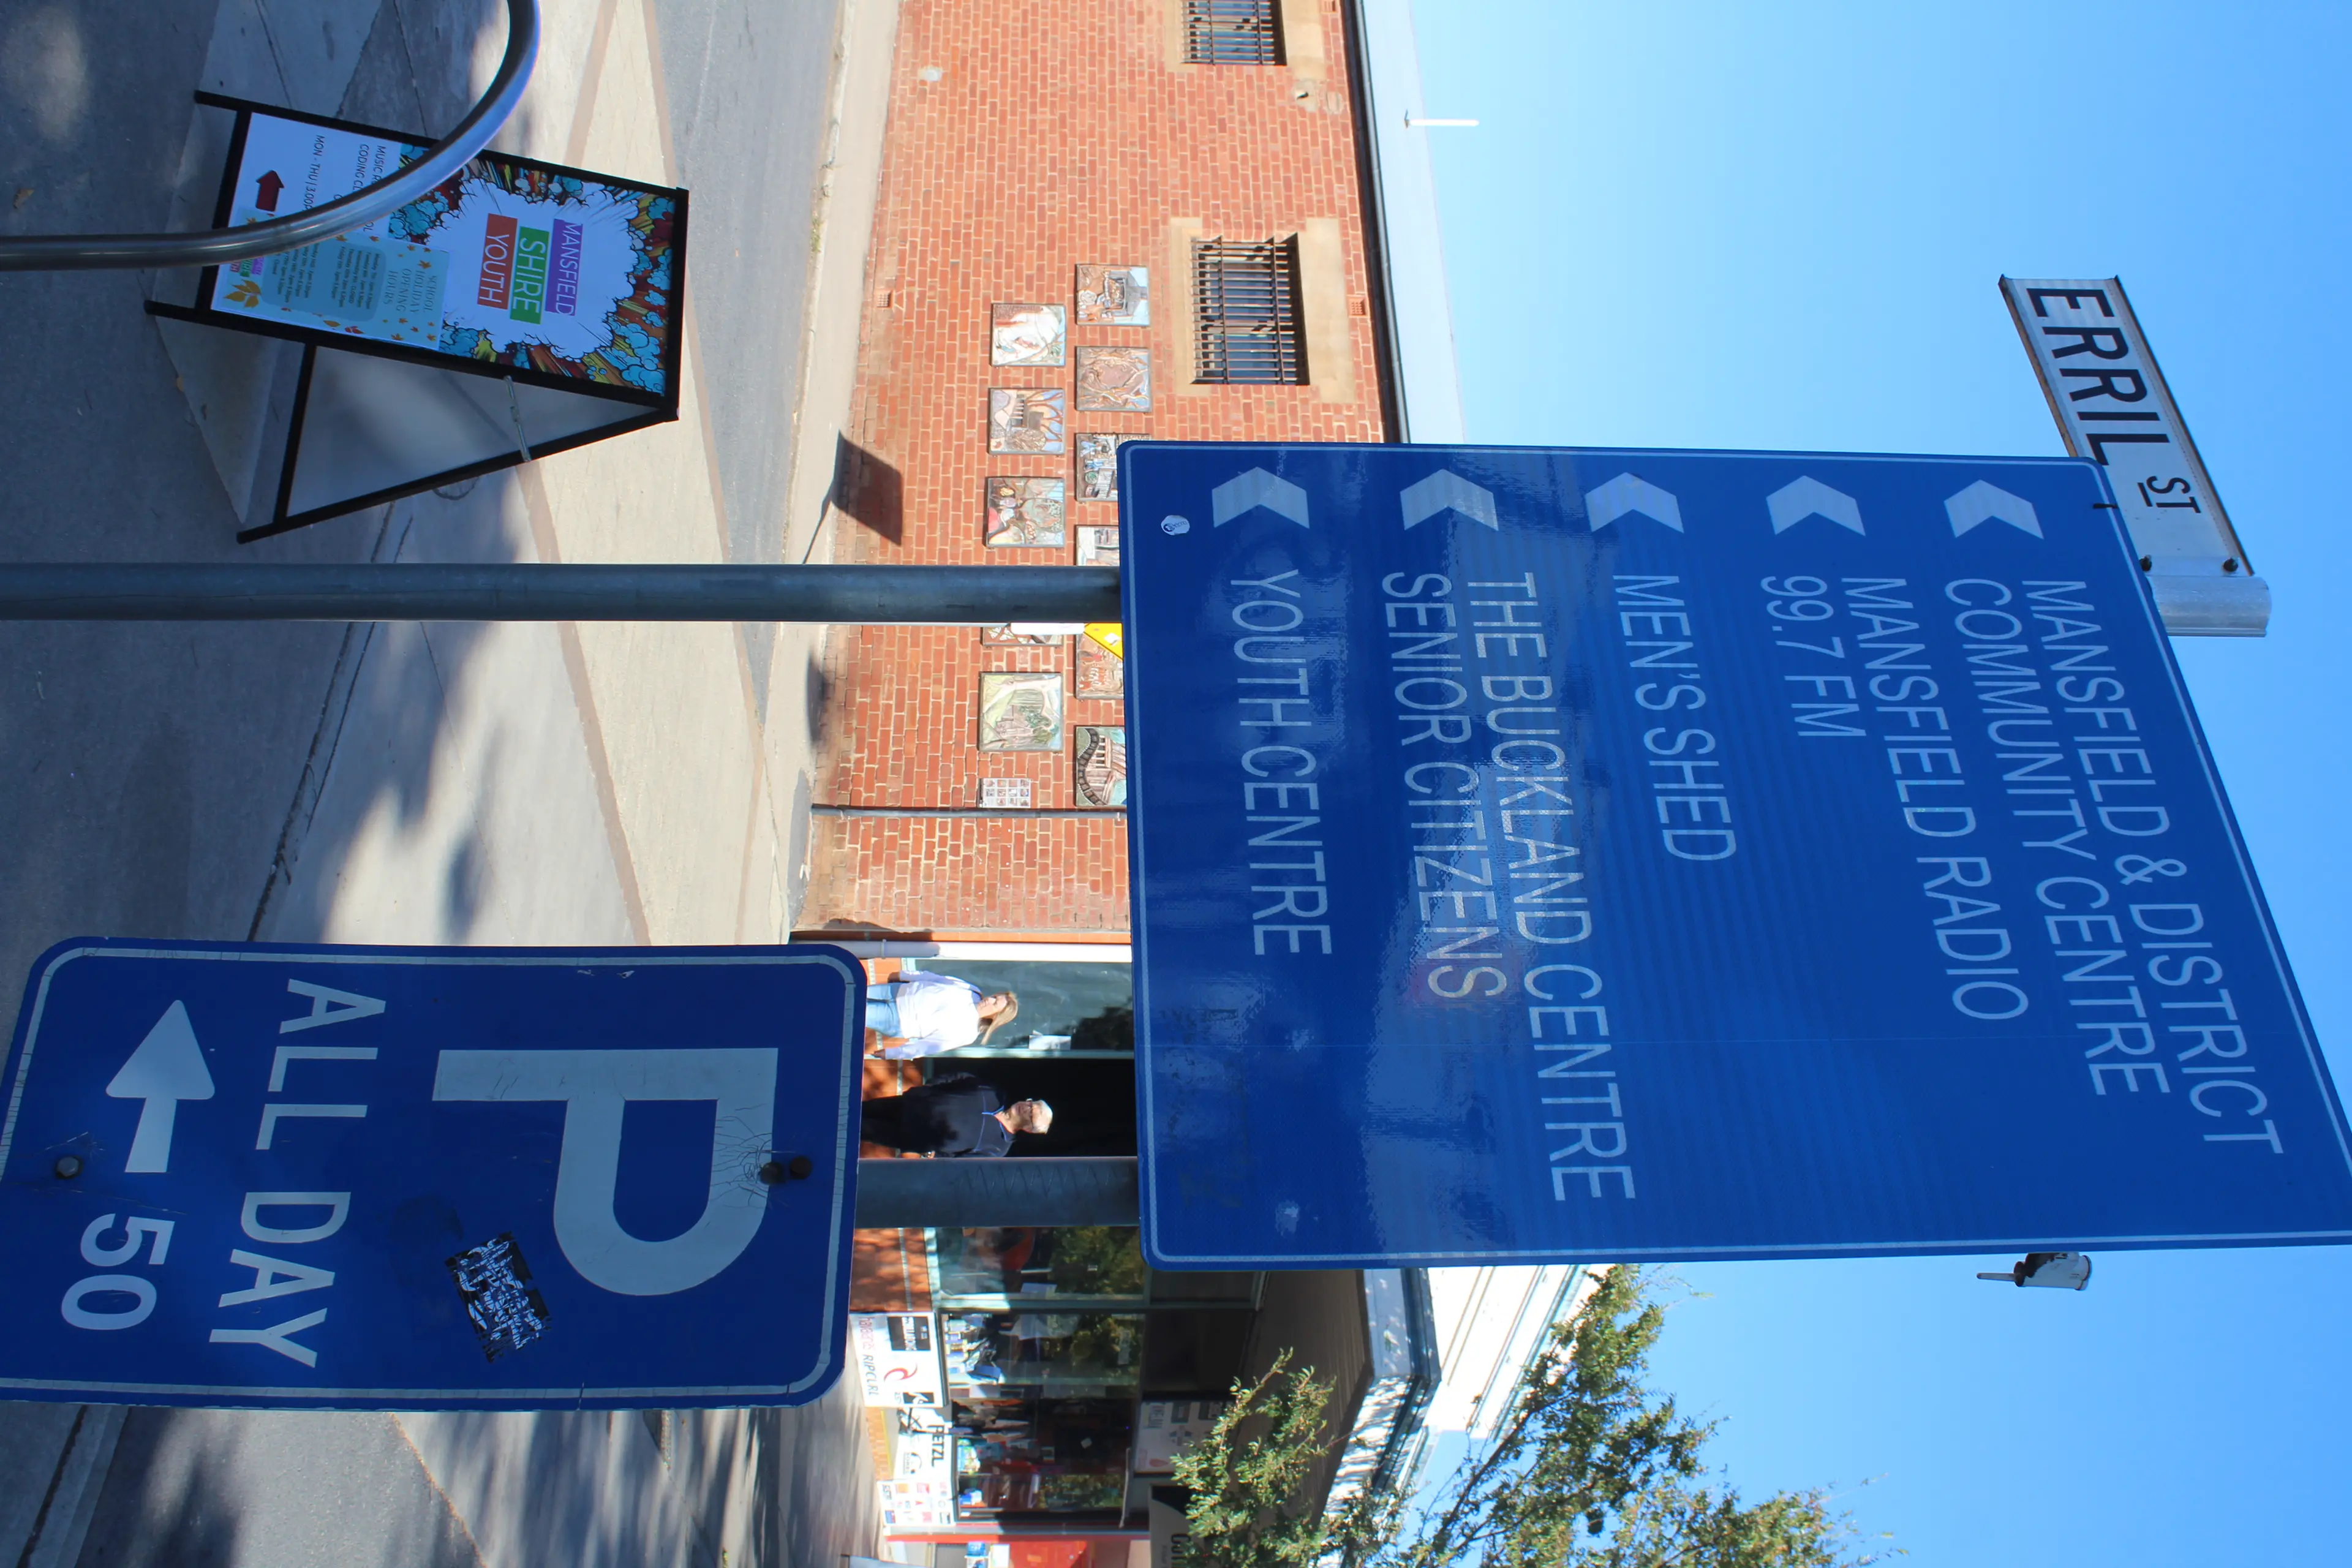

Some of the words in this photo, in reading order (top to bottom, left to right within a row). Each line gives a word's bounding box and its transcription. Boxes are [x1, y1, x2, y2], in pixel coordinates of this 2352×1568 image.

[301, 186, 316, 211] 3.00P
[307, 164, 321, 181] THU
[312, 135, 325, 156] MON
[354, 144, 370, 178] CODING
[372, 145, 386, 173] MUSIC
[383, 270, 399, 306] HOURS
[396, 268, 412, 312] OPENING
[409, 270, 426, 315] HOLIDAY
[423, 275, 437, 314] SCHOOL
[479, 234, 510, 303] YOUTH
[512, 238, 546, 314] SHIRE
[555, 222, 582, 315] MANSFIELD
[2026, 288, 2170, 466] ERRIL
[2145, 475, 2201, 513] ST
[1229, 568, 1314, 727] YOUTH
[1381, 572, 1474, 747] SENIOR
[1466, 572, 1547, 658] THE
[1612, 575, 1708, 710] MEN'S
[1759, 575, 1844, 660] 99.7
[1785, 676, 1866, 737] FM
[2021, 581, 2170, 838] MANSFIELD
[1240, 745, 1333, 956] CENTRE
[1478, 674, 1593, 944] BUCKLAND
[1641, 727, 1738, 861] SHED
[1841, 576, 1977, 839] MANSFIELD
[1914, 857, 2029, 1021] RADIO
[1944, 578, 2096, 861] COMMUNITY
[2035, 876, 2171, 1096] CENTRE
[1403, 761, 1509, 1000] CITIZENS
[2114, 854, 2187, 886] &
[255, 979, 386, 1150] ALL
[1524, 963, 1637, 1202] CENTRE
[2128, 904, 2284, 1155] DISTRICT
[431, 1047, 778, 1297] P
[61, 1213, 176, 1331] 50
[209, 1191, 352, 1369] DAY
